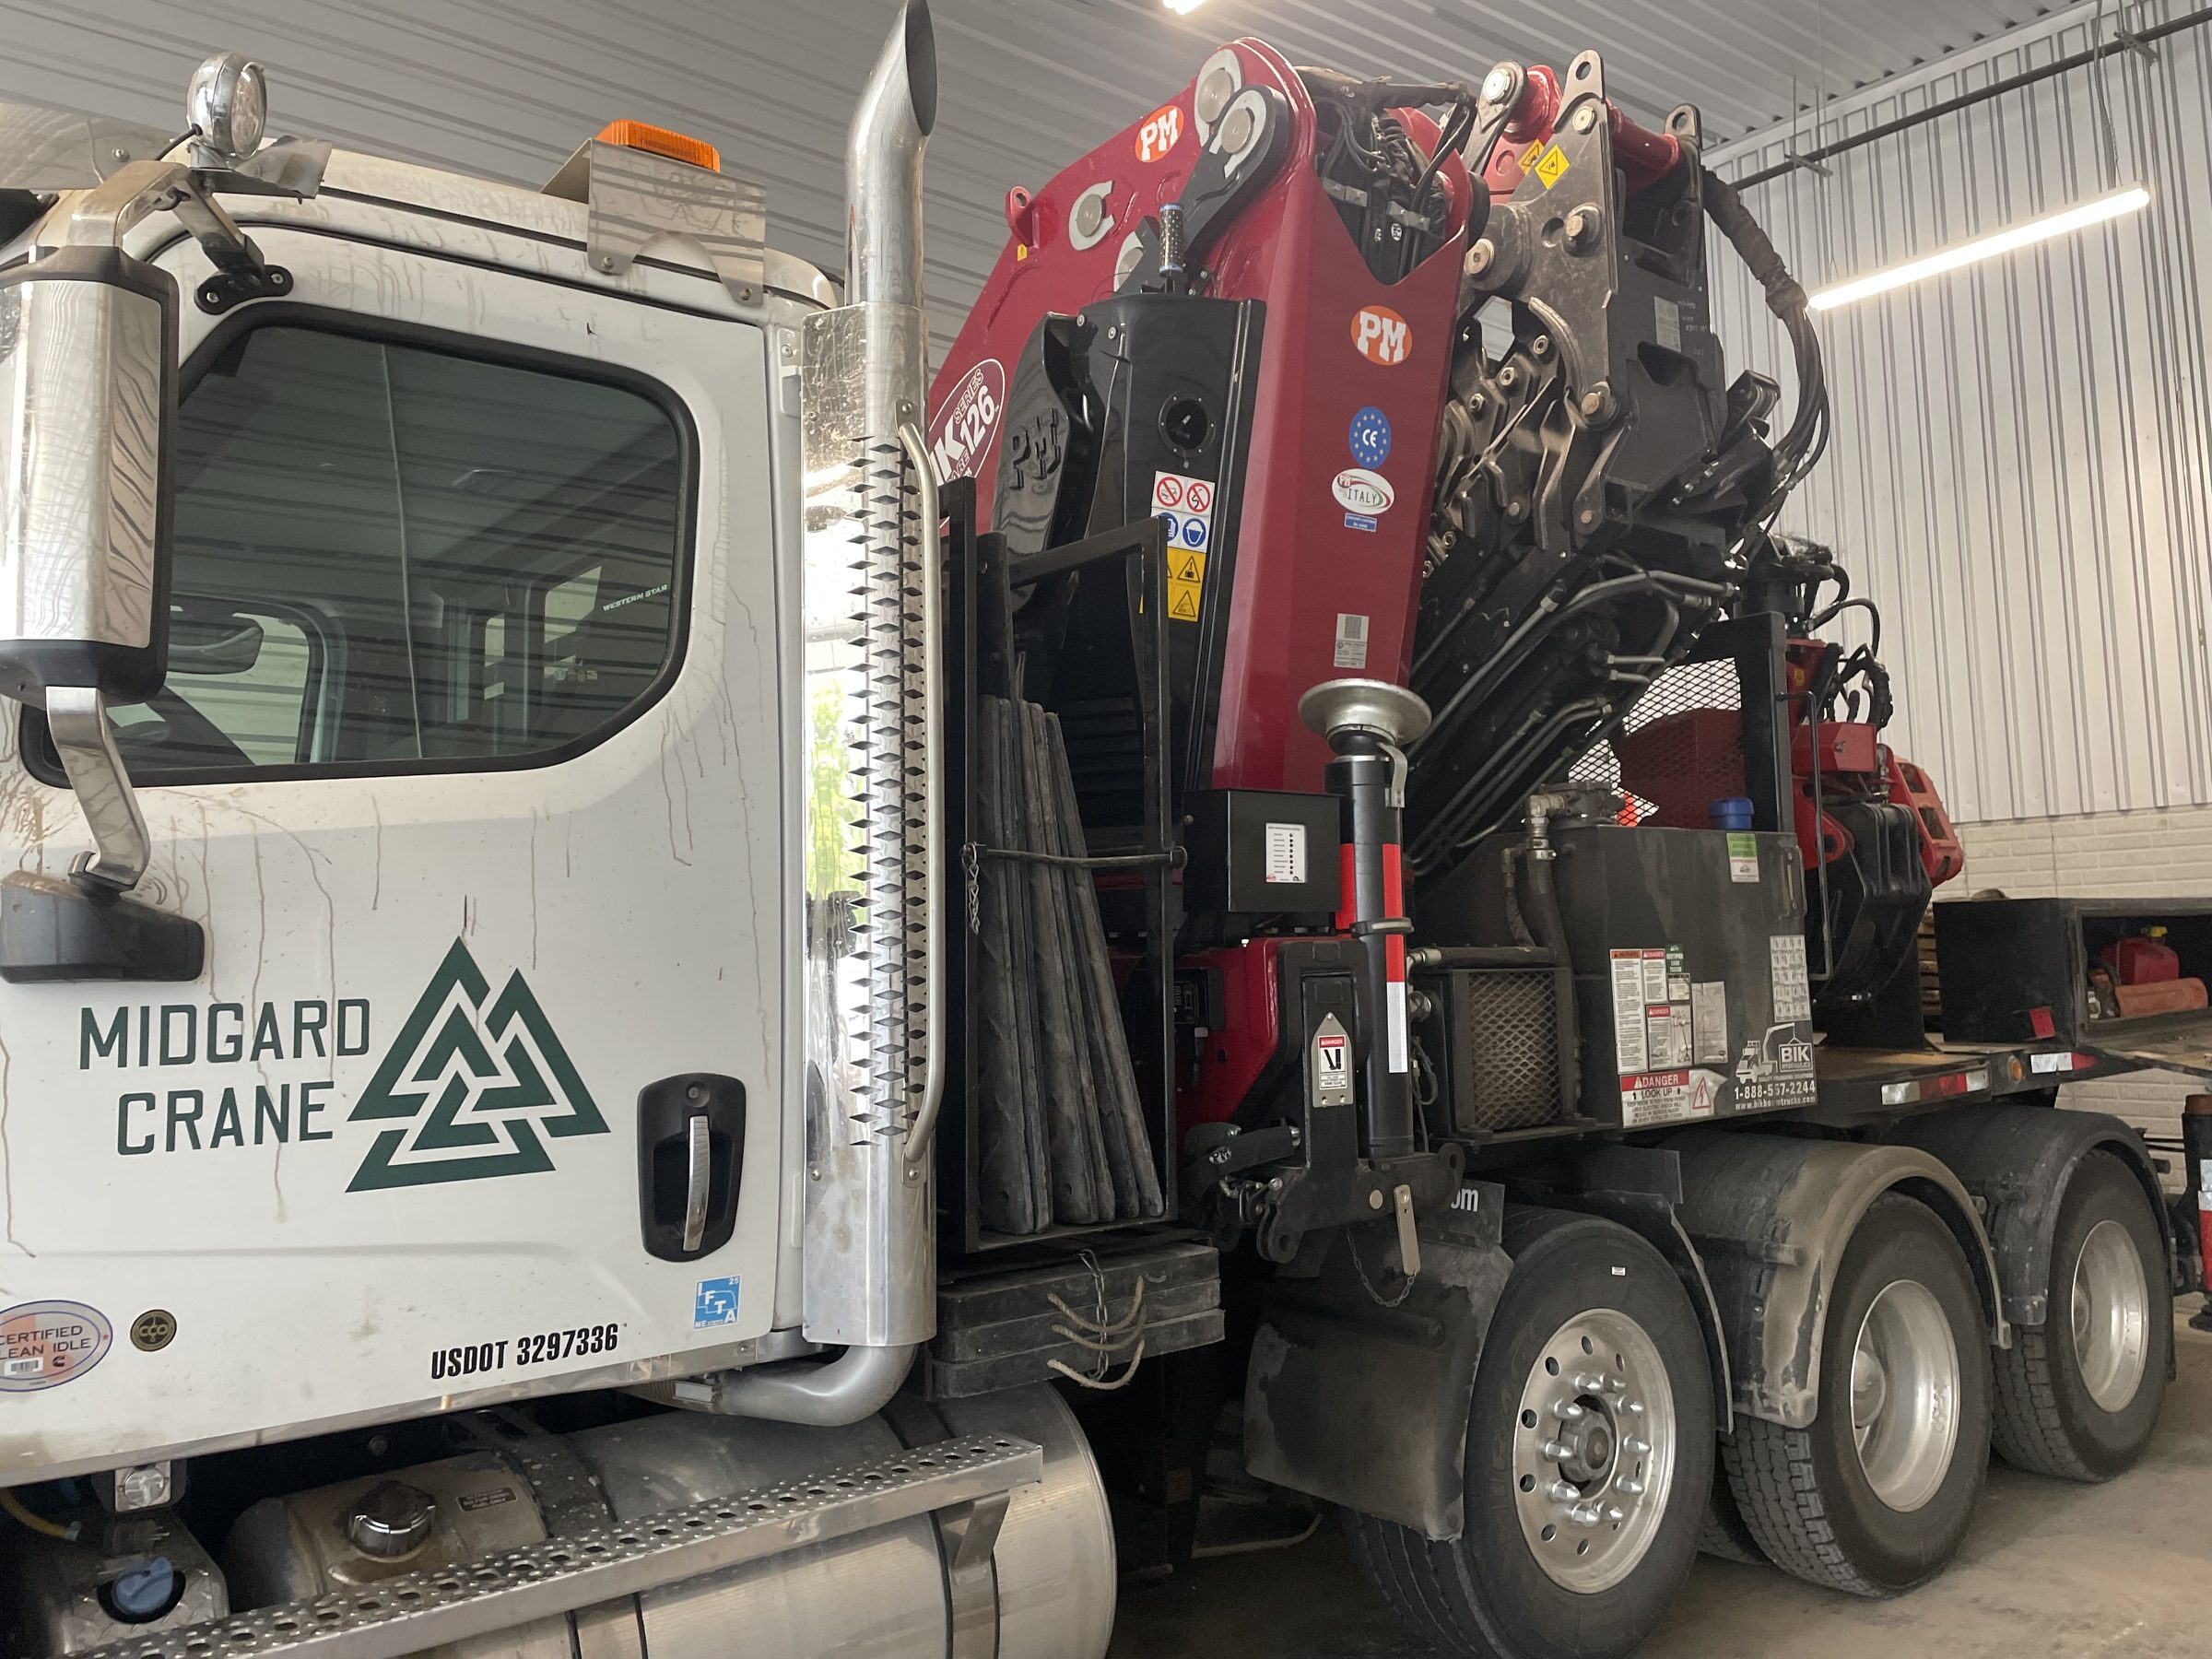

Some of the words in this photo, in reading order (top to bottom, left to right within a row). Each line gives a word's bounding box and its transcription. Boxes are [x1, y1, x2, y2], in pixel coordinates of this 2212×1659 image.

[1139, 106, 1179, 161] PM
[1358, 311, 1406, 362] PM
[954, 369, 984, 425] SERIES
[960, 385, 995, 455] 126
[1347, 488, 1378, 505] ITALY
[603, 592, 644, 612] WESTERN
[645, 583, 668, 598] STAR
[79, 998, 371, 1071] MIDGARD
[1781, 1045, 1810, 1063] BIK
[1641, 1074, 1679, 1088] DANGER
[1641, 1088, 1661, 1100] LOOK
[1663, 1088, 1673, 1097] UP
[117, 1081, 335, 1156] CRANE
[1735, 1096, 1816, 1111] www.bikbomtrucks.com
[53, 1337, 91, 1353] IDLE
[430, 1341, 507, 1381] USDOT
[516, 1323, 618, 1367] 3297336
